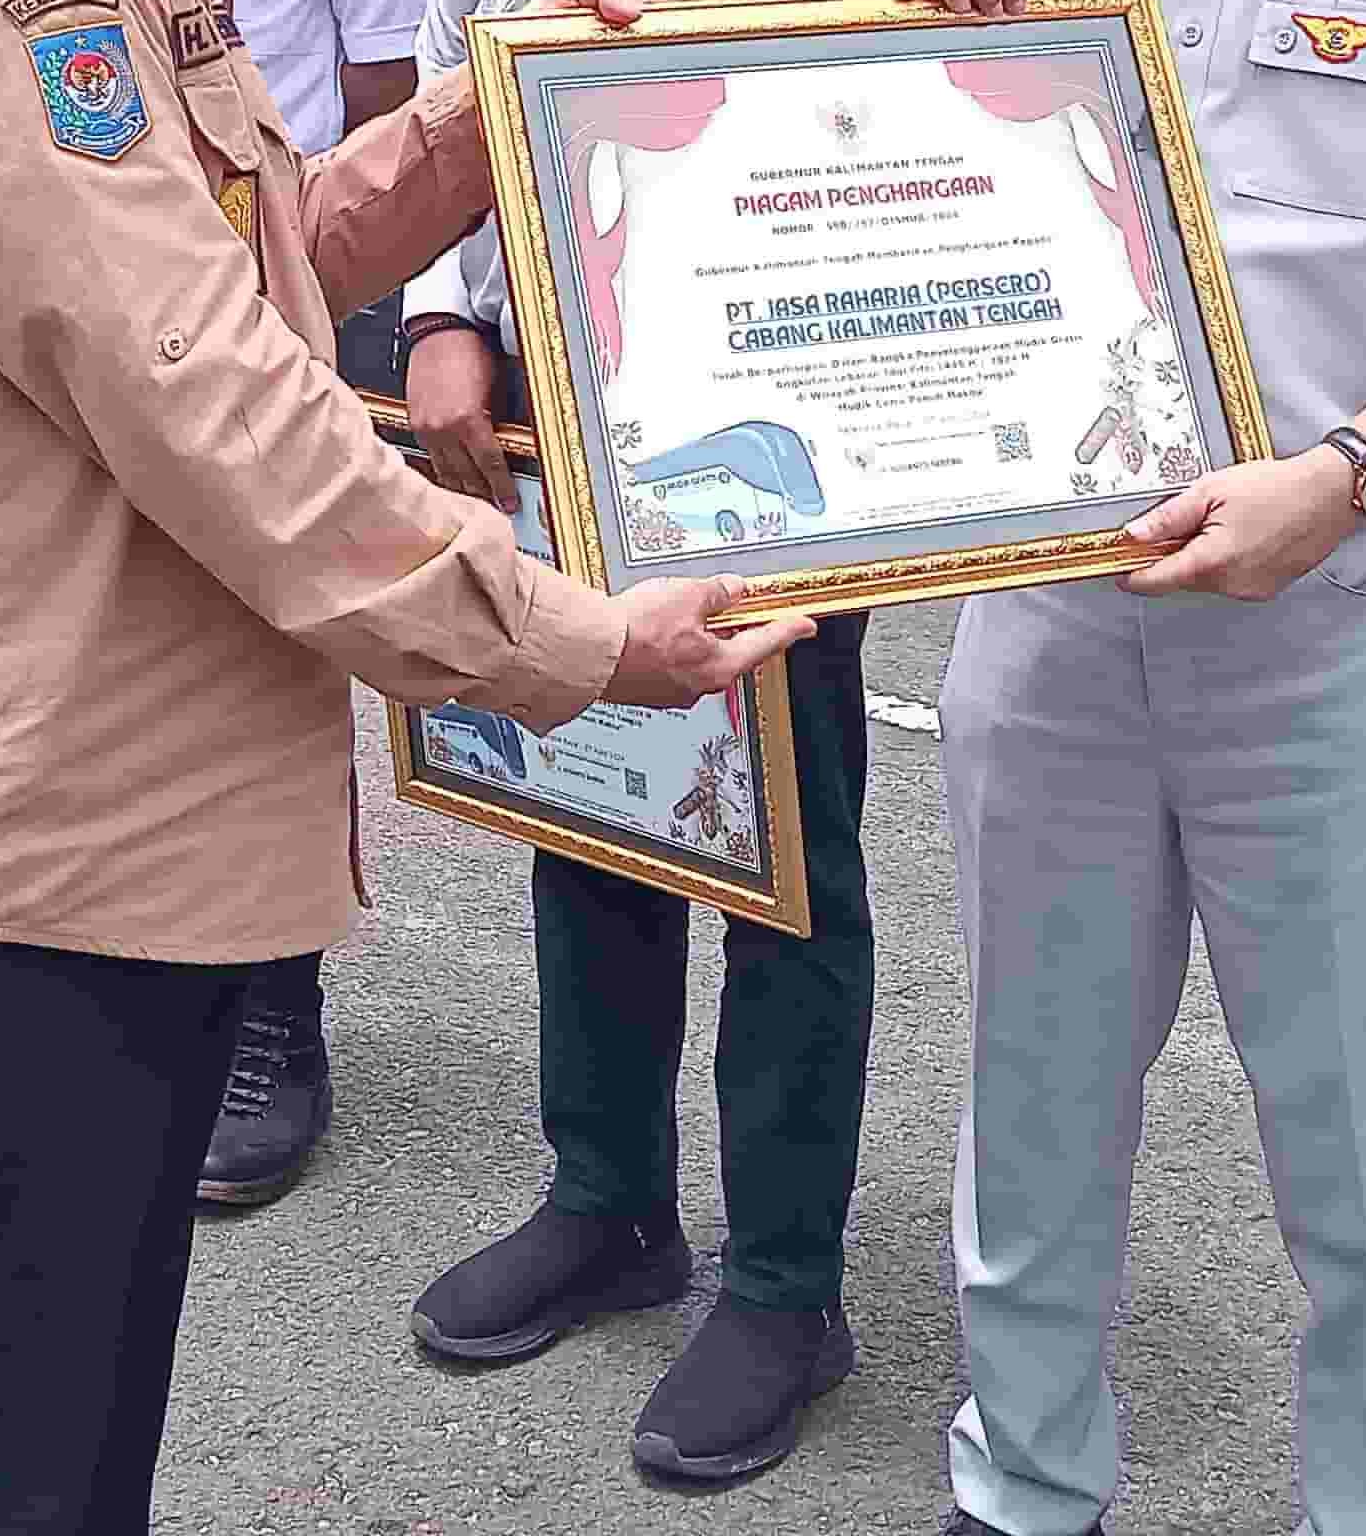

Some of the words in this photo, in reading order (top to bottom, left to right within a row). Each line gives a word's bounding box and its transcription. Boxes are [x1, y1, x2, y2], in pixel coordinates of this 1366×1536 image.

[749, 167, 822, 182] GUBERNUR
[826, 158, 910, 176] KALIMANTAN
[914, 154, 965, 168] TENGAH
[734, 189, 823, 217] PIAGAM
[826, 175, 996, 208] PENGHARGAAN
[725, 301, 763, 324] PT.
[767, 293, 821, 319] JASA
[824, 284, 921, 314] RAHARJA
[926, 267, 1052, 306] (PERSERO)
[728, 321, 823, 350] CABANG
[827, 305, 969, 341] KALIMANTAN
[970, 296, 1064, 325] TENGAH
